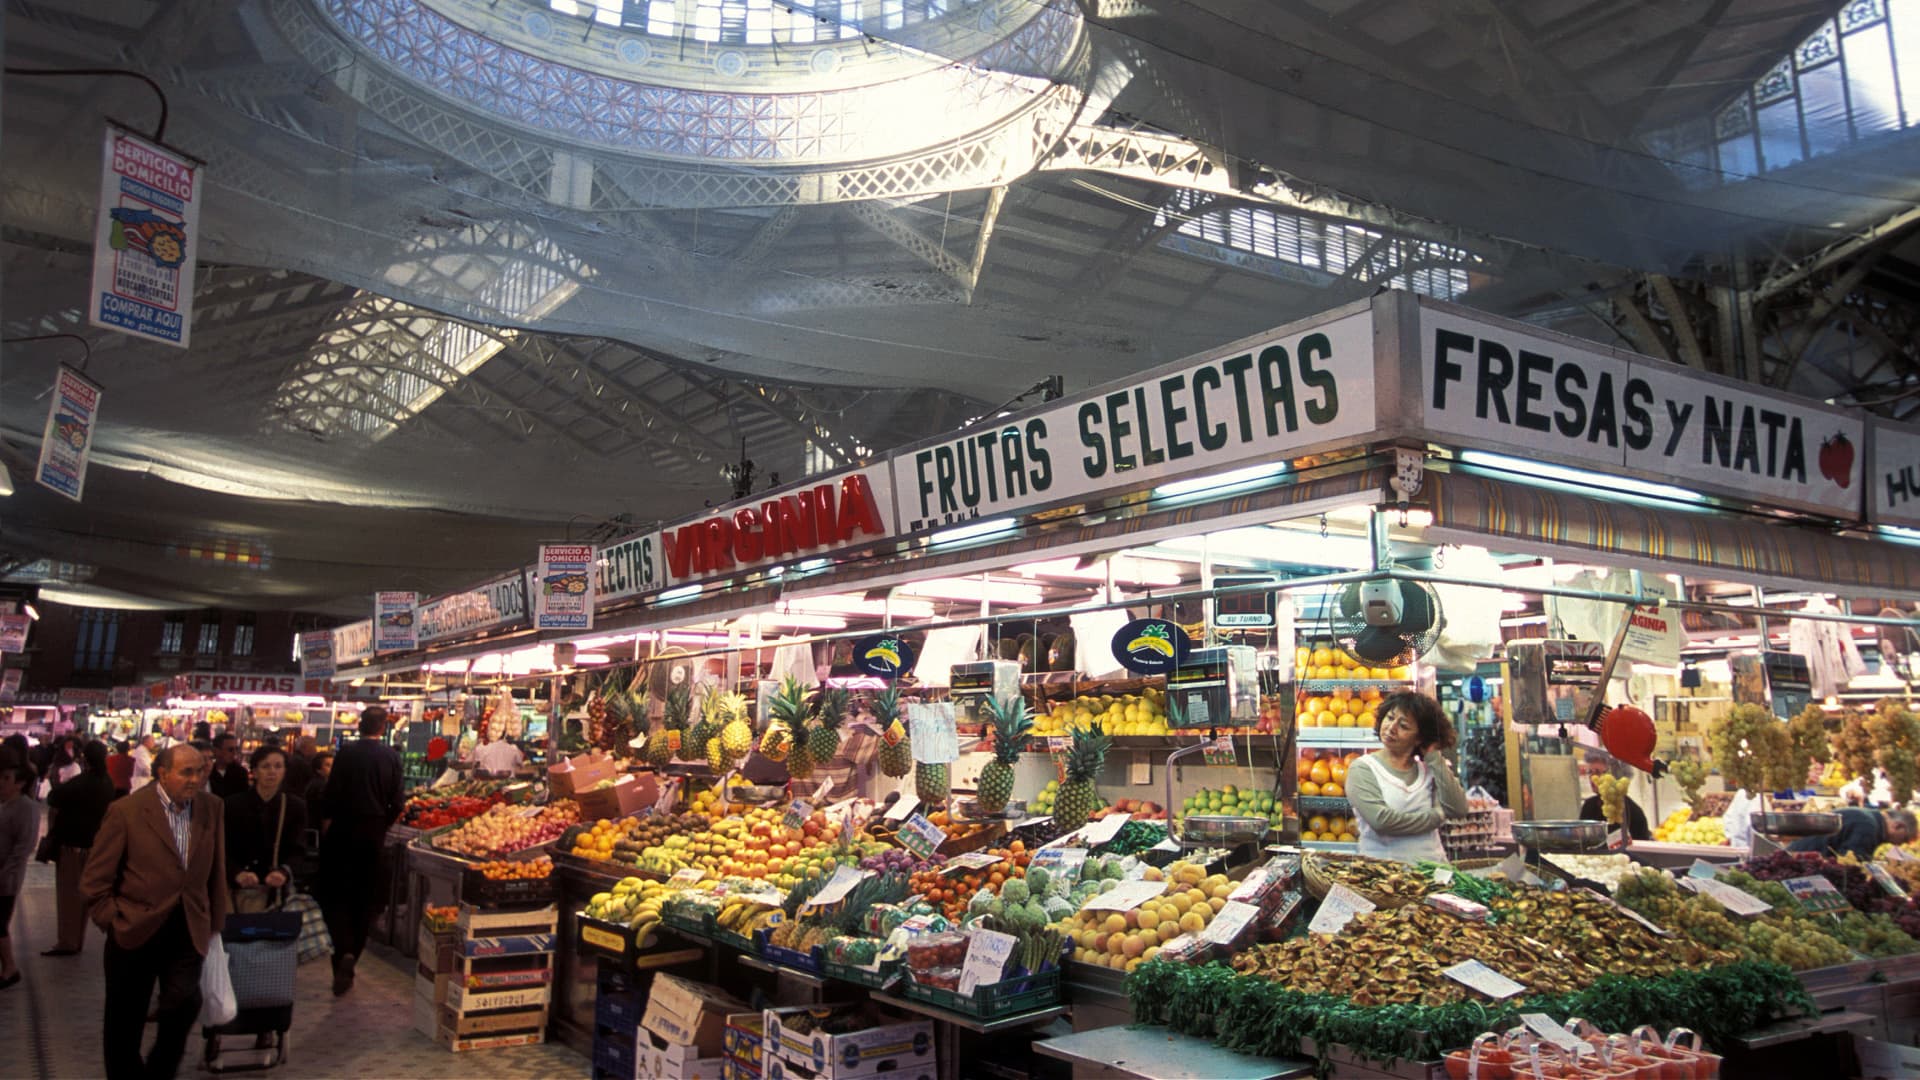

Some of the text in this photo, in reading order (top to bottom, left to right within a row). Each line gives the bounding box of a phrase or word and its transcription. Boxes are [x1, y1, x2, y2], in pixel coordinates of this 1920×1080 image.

[115, 156, 191, 199] DOMICILIO
[116, 141, 191, 184] SERVICIO A
[103, 295, 154, 321] COMPRAR
[103, 313, 120, 322] no
[1431, 327, 1655, 452] FRESAS
[1702, 394, 1807, 485] NATA
[914, 331, 1341, 519] FRUTAS SELECTAS
[661, 474, 886, 579] VIRGINIA
[1240, 615, 1263, 623] TURNO
[1631, 613, 1668, 633] RGINIA
[194, 675, 295, 693] FRUTAS
